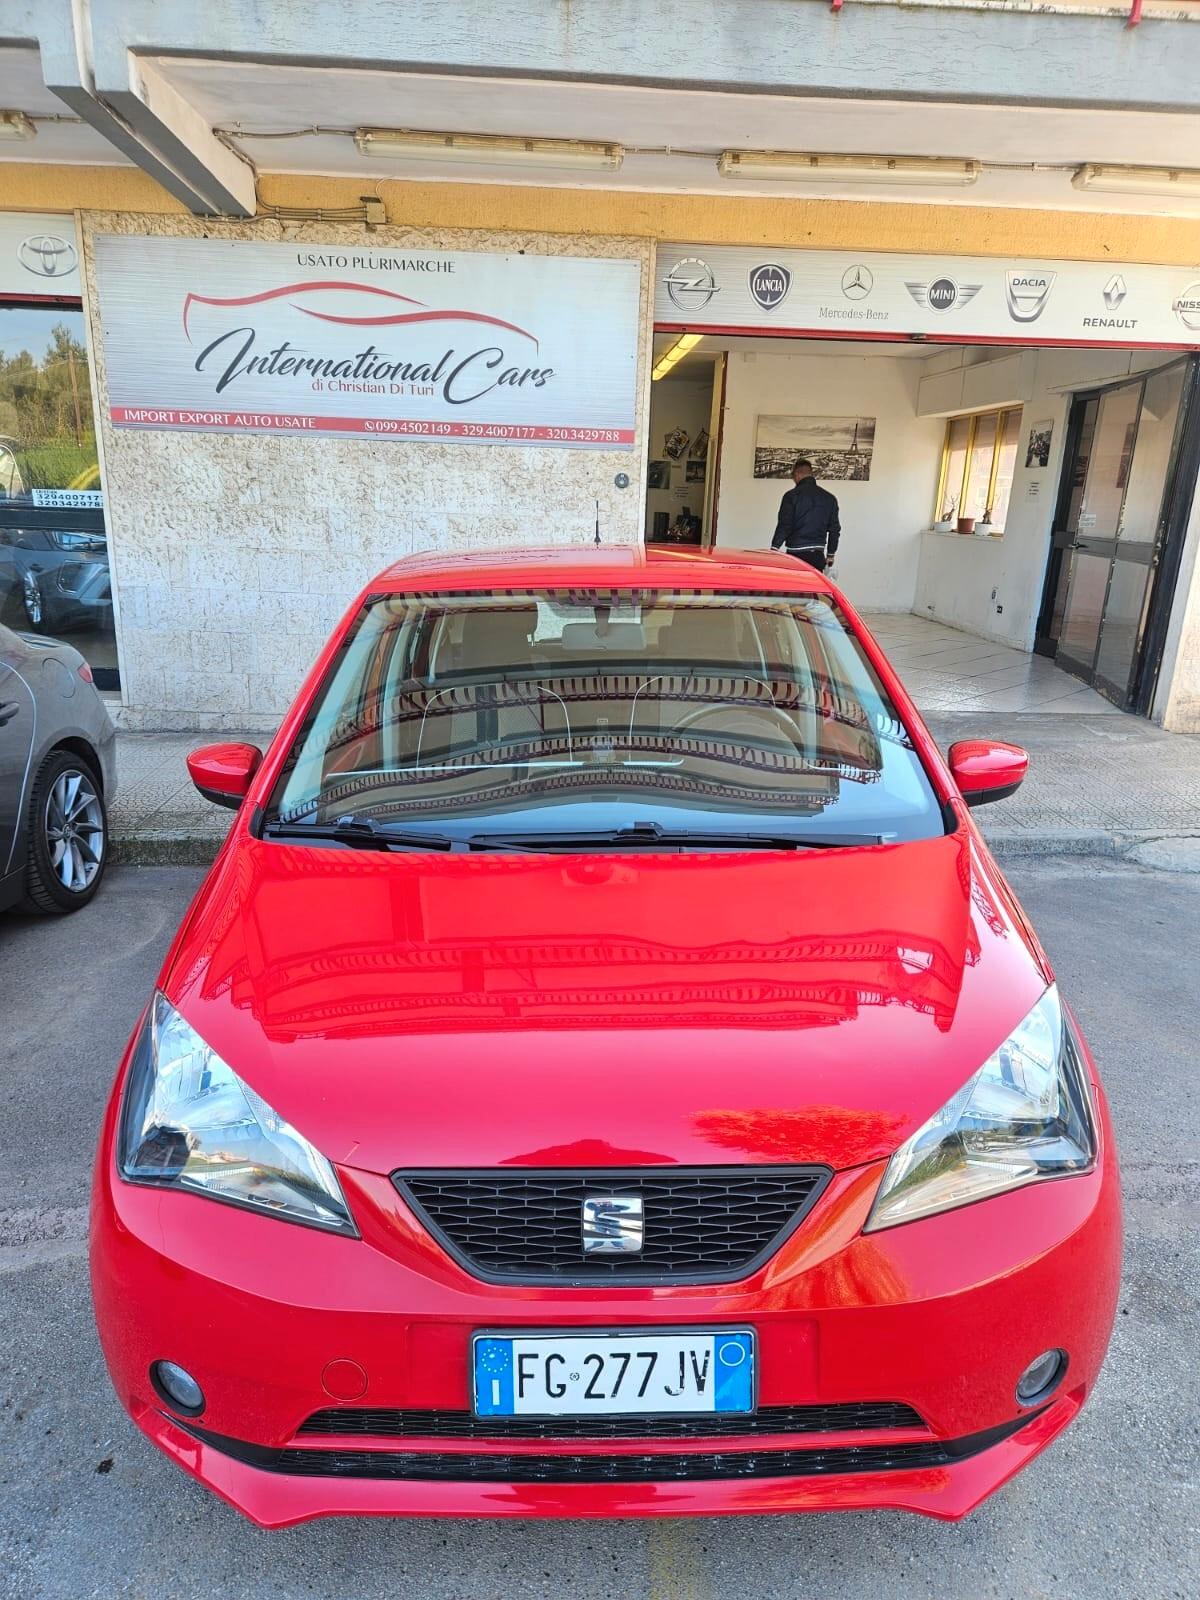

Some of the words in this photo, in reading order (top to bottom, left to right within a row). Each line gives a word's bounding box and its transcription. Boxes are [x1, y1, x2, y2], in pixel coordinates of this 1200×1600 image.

[297, 254, 348, 268] USATO
[352, 256, 456, 274] PLURIMARCHE
[756, 279, 783, 292] LANCIA
[1012, 278, 1047, 287] DACIA
[930, 289, 955, 300] MINI
[818, 307, 889, 320] Mercedes-Benz
[1082, 318, 1138, 329] RENAULT
[195, 327, 454, 394] International
[443, 347, 556, 405] Cars
[311, 379, 324, 391] di
[327, 380, 386, 394] Christian
[390, 382, 405, 395] Di
[410, 383, 434, 396] Turi
[124, 409, 177, 423] IMPORT
[179, 412, 231, 425] EXPORT
[234, 414, 272, 427] AUTO
[275, 416, 316, 428] USATE
[376, 420, 451, 435] 099.4502149
[462, 424, 536, 439] 329.4007177
[546, 428, 620, 442] 320.3429788
[518, 1353, 567, 1399] FG
[583, 1352, 658, 1399] 277
[664, 1350, 711, 1396] JV
